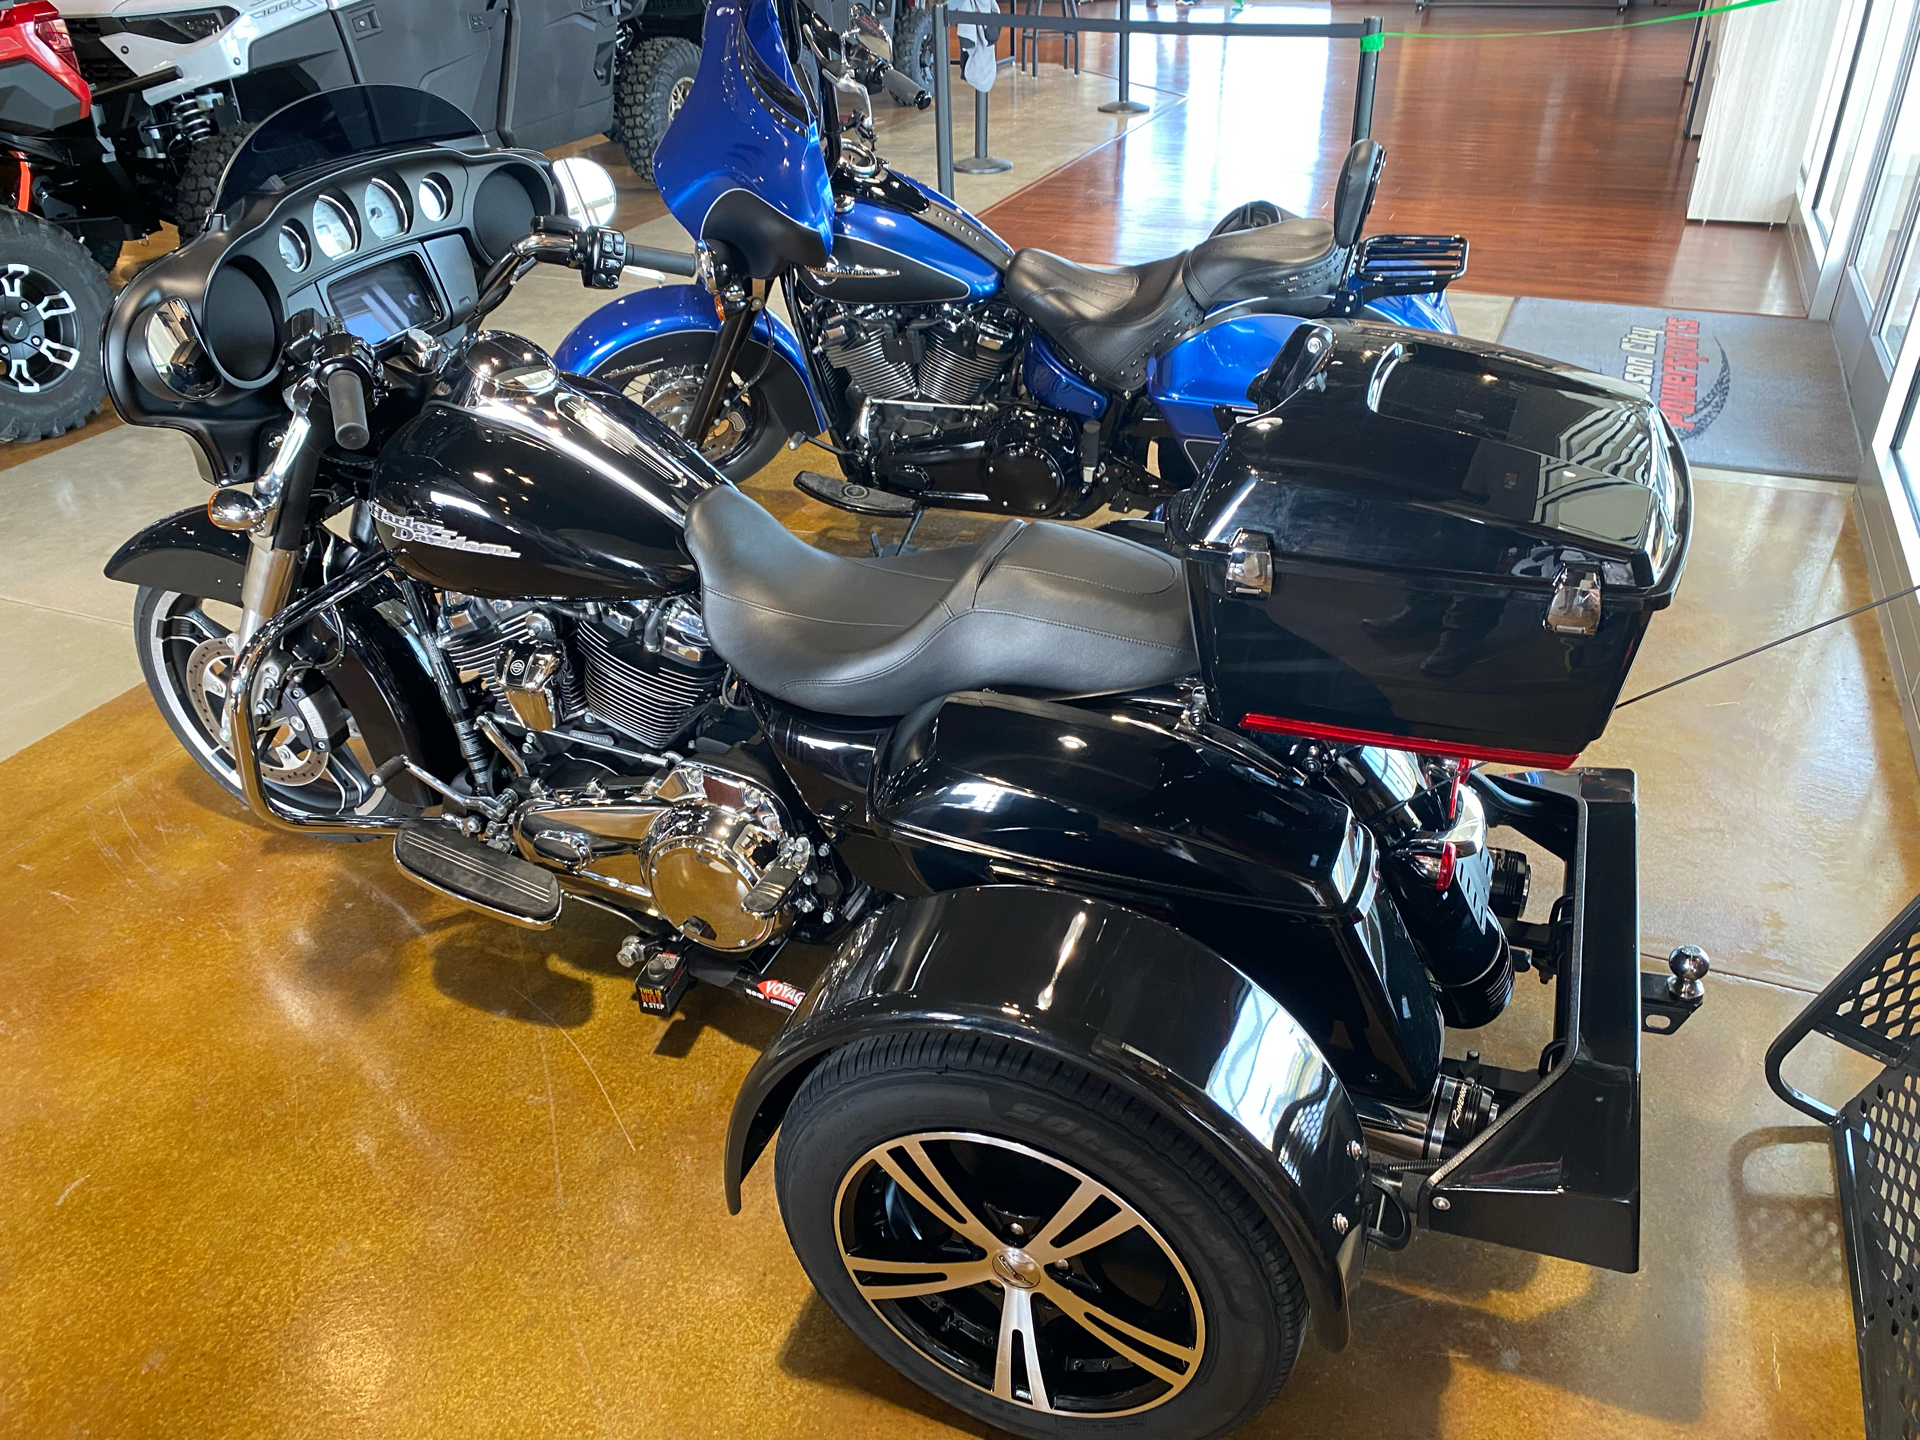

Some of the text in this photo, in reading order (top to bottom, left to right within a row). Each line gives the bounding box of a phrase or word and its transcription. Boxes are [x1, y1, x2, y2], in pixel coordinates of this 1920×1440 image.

[1620, 326, 1665, 355] City
[1658, 317, 1709, 429] Powersports
[392, 525, 521, 558] Davidson
[639, 987, 654, 995] THIS
[641, 993, 662, 1004] NOT
[765, 980, 806, 1005] VOYAG
[649, 1002, 665, 1010] STEP
